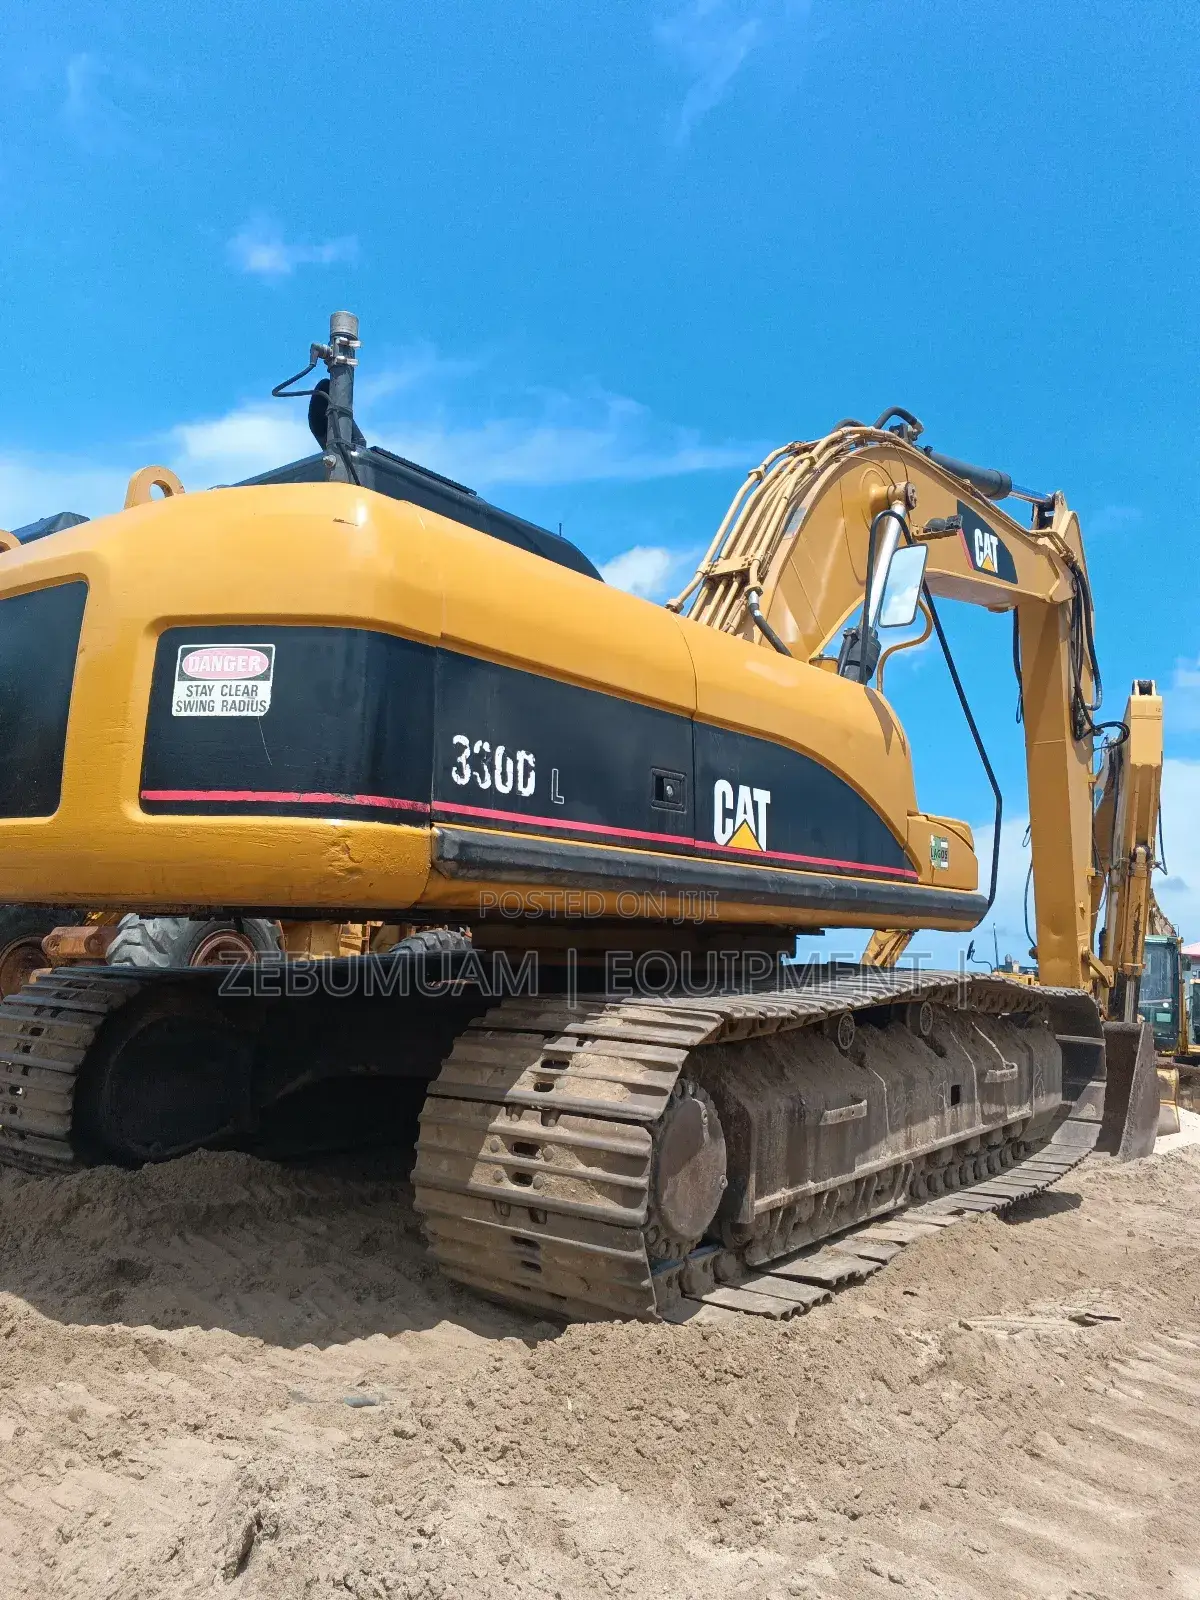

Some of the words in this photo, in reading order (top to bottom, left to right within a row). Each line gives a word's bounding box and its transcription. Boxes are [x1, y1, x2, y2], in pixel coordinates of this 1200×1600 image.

[974, 528, 998, 573] CAT
[188, 655, 261, 672] DANGER
[186, 685, 215, 697] STAY
[220, 685, 258, 697] CLEAR
[175, 700, 215, 712] SWING
[221, 700, 266, 712] RADIUS
[551, 768, 565, 805] L
[714, 779, 771, 852] CAT
